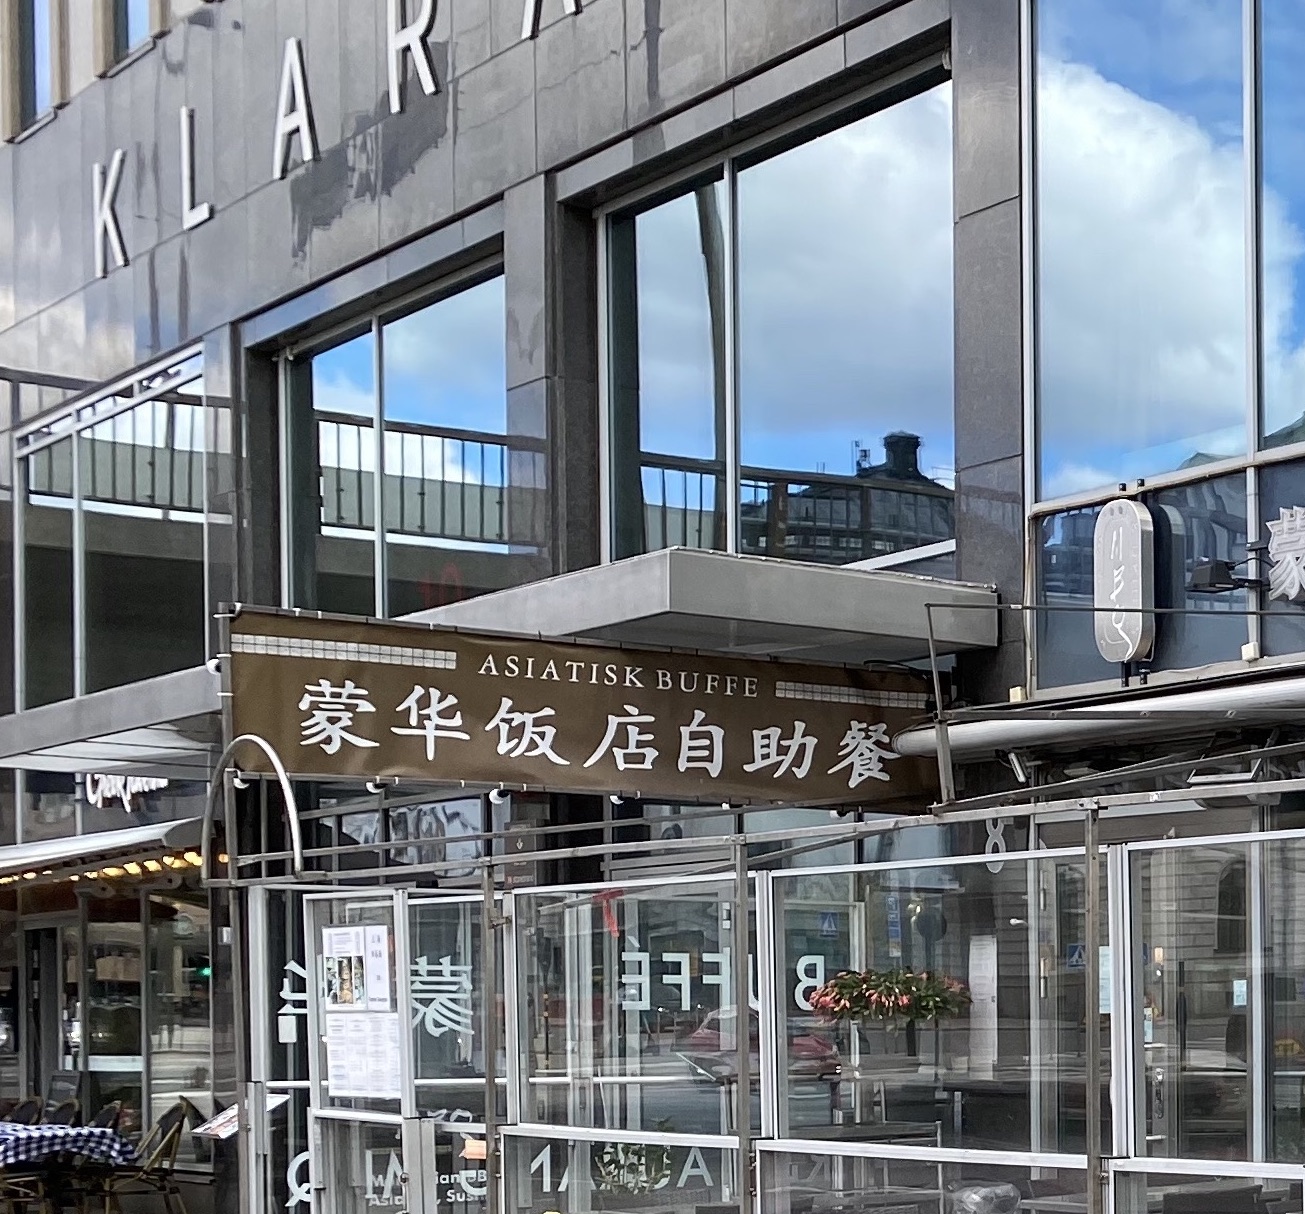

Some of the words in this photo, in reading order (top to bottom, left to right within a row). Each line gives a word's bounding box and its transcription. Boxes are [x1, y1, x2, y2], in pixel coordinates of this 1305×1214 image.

[92, 0, 584, 278] KLAR
[478, 654, 644, 688] ASIATISK
[656, 669, 759, 699] BUFFE
[298, 678, 902, 789] 蒙华饭店自助餐
